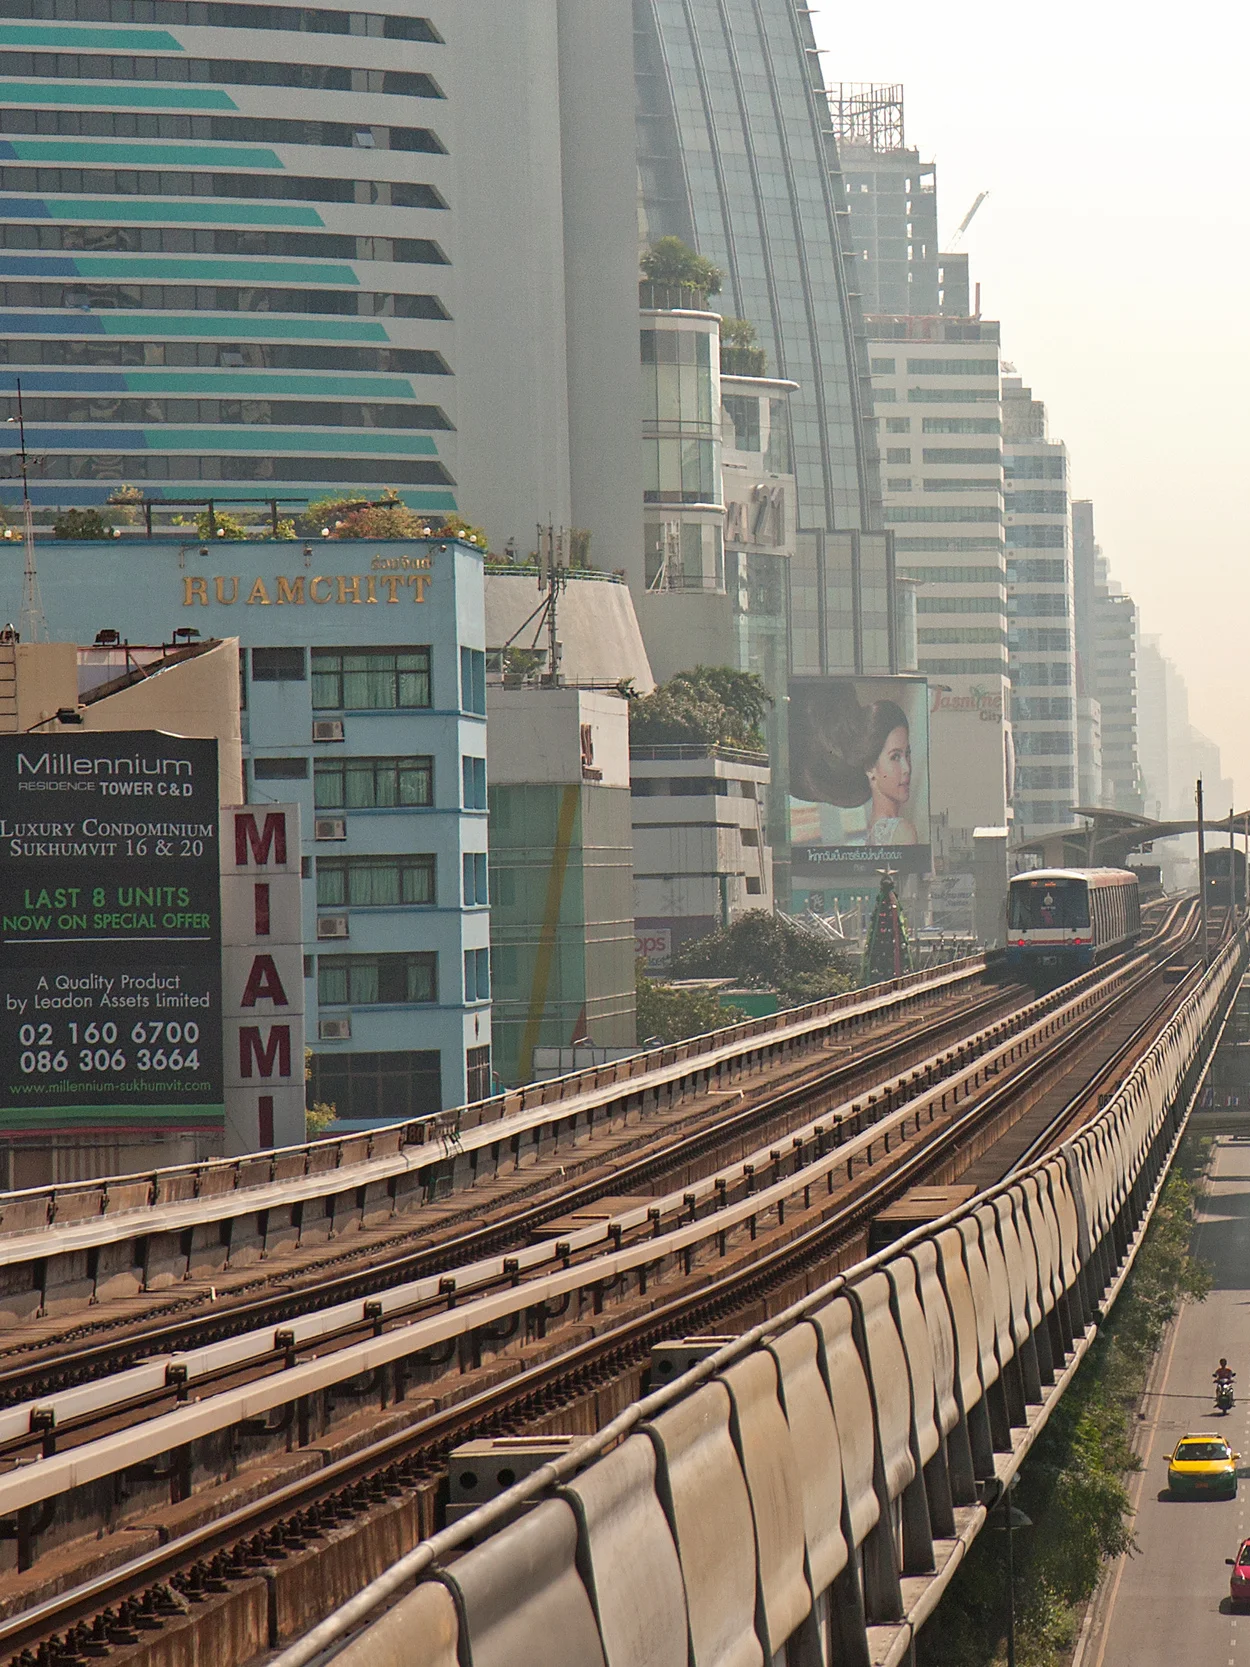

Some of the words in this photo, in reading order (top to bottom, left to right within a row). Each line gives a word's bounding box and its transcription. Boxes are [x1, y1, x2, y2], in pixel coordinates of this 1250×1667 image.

[183, 574, 432, 606] RUAMCHITT
[979, 710, 1003, 724] City
[17, 753, 193, 776] Millennium
[18, 781, 96, 792] RESIDENCE
[100, 782, 154, 796] TOWER
[126, 838, 147, 856] 16
[155, 839, 173, 857] &
[179, 839, 204, 857] 20
[24, 888, 81, 909] LAST
[92, 887, 106, 908] 8
[118, 886, 190, 908] UNITS
[3, 914, 51, 931] NOW
[58, 914, 87, 930] ON
[93, 913, 157, 929] SPECIAL
[162, 912, 210, 929] OFFER
[36, 976, 49, 990] A
[55, 973, 115, 993] Quality
[121, 973, 181, 989] Product
[233, 812, 291, 1149] MIAMI
[6, 993, 28, 1014] by
[34, 992, 93, 1009] Leadon
[99, 993, 151, 1008] Assets
[156, 992, 211, 1008] Limited
[19, 1023, 53, 1046] 02
[68, 1022, 119, 1044] 160
[131, 1021, 200, 1044] 6700
[20, 1050, 69, 1073] 086
[79, 1049, 127, 1071] 306
[136, 1048, 201, 1071] 3664
[9, 1078, 212, 1095] www.millennium-sukhumvit.com
